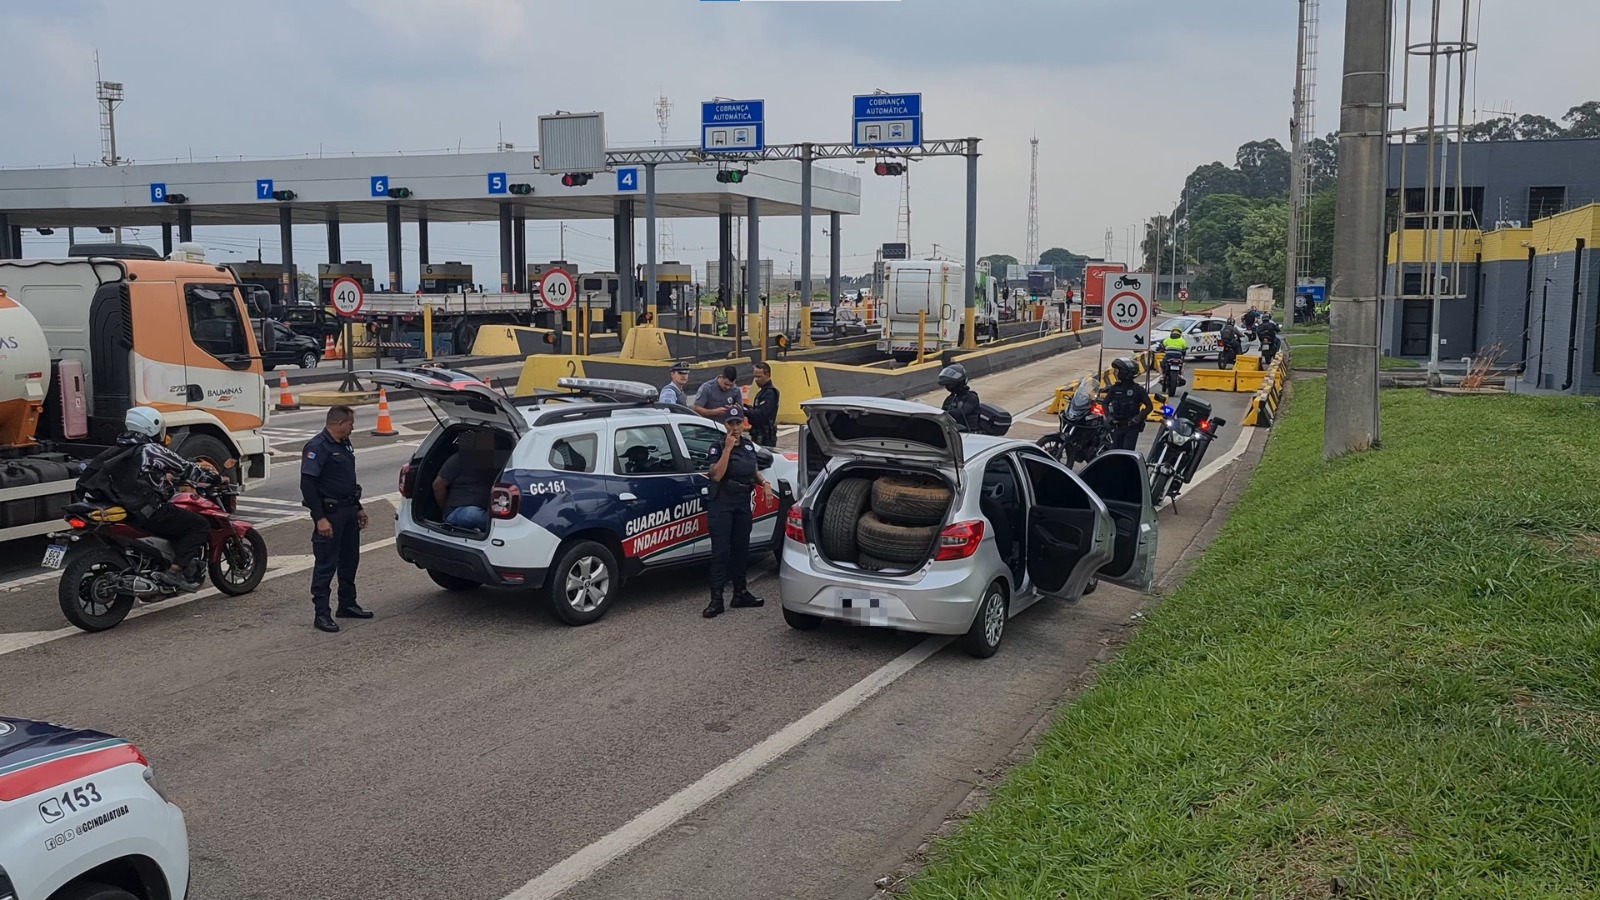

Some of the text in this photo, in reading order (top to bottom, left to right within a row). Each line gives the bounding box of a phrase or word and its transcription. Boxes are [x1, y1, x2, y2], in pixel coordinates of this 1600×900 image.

[715, 104, 749, 112] COBRANÇA
[869, 98, 905, 106] COBRANÇA
[713, 112, 752, 121] AUTOMÁTICA
[866, 106, 908, 115] AUTOMÁTICA
[375, 181, 385, 192] 6
[492, 177, 502, 189] 5
[621, 175, 633, 186] 4
[154, 187, 163, 199] 8
[260, 183, 269, 195] 7
[325, 265, 331, 274] 7
[426, 265, 433, 275] 6
[534, 265, 542, 275] 5
[547, 282, 567, 296] 40
[338, 290, 356, 303] 40
[1116, 303, 1138, 318] 30
[506, 328, 514, 341] 4
[655, 332, 663, 346] 3
[1190, 344, 1218, 353] POLIC
[566, 360, 579, 378] 2
[207, 386, 243, 397] BAUMINAS
[529, 479, 566, 496] GC-161
[625, 497, 704, 537] GUARDA CIVIL
[632, 519, 699, 554] INDAIATUBA
[61, 782, 102, 813] 153
[76, 805, 129, 835] @GCINDAIATUBA
